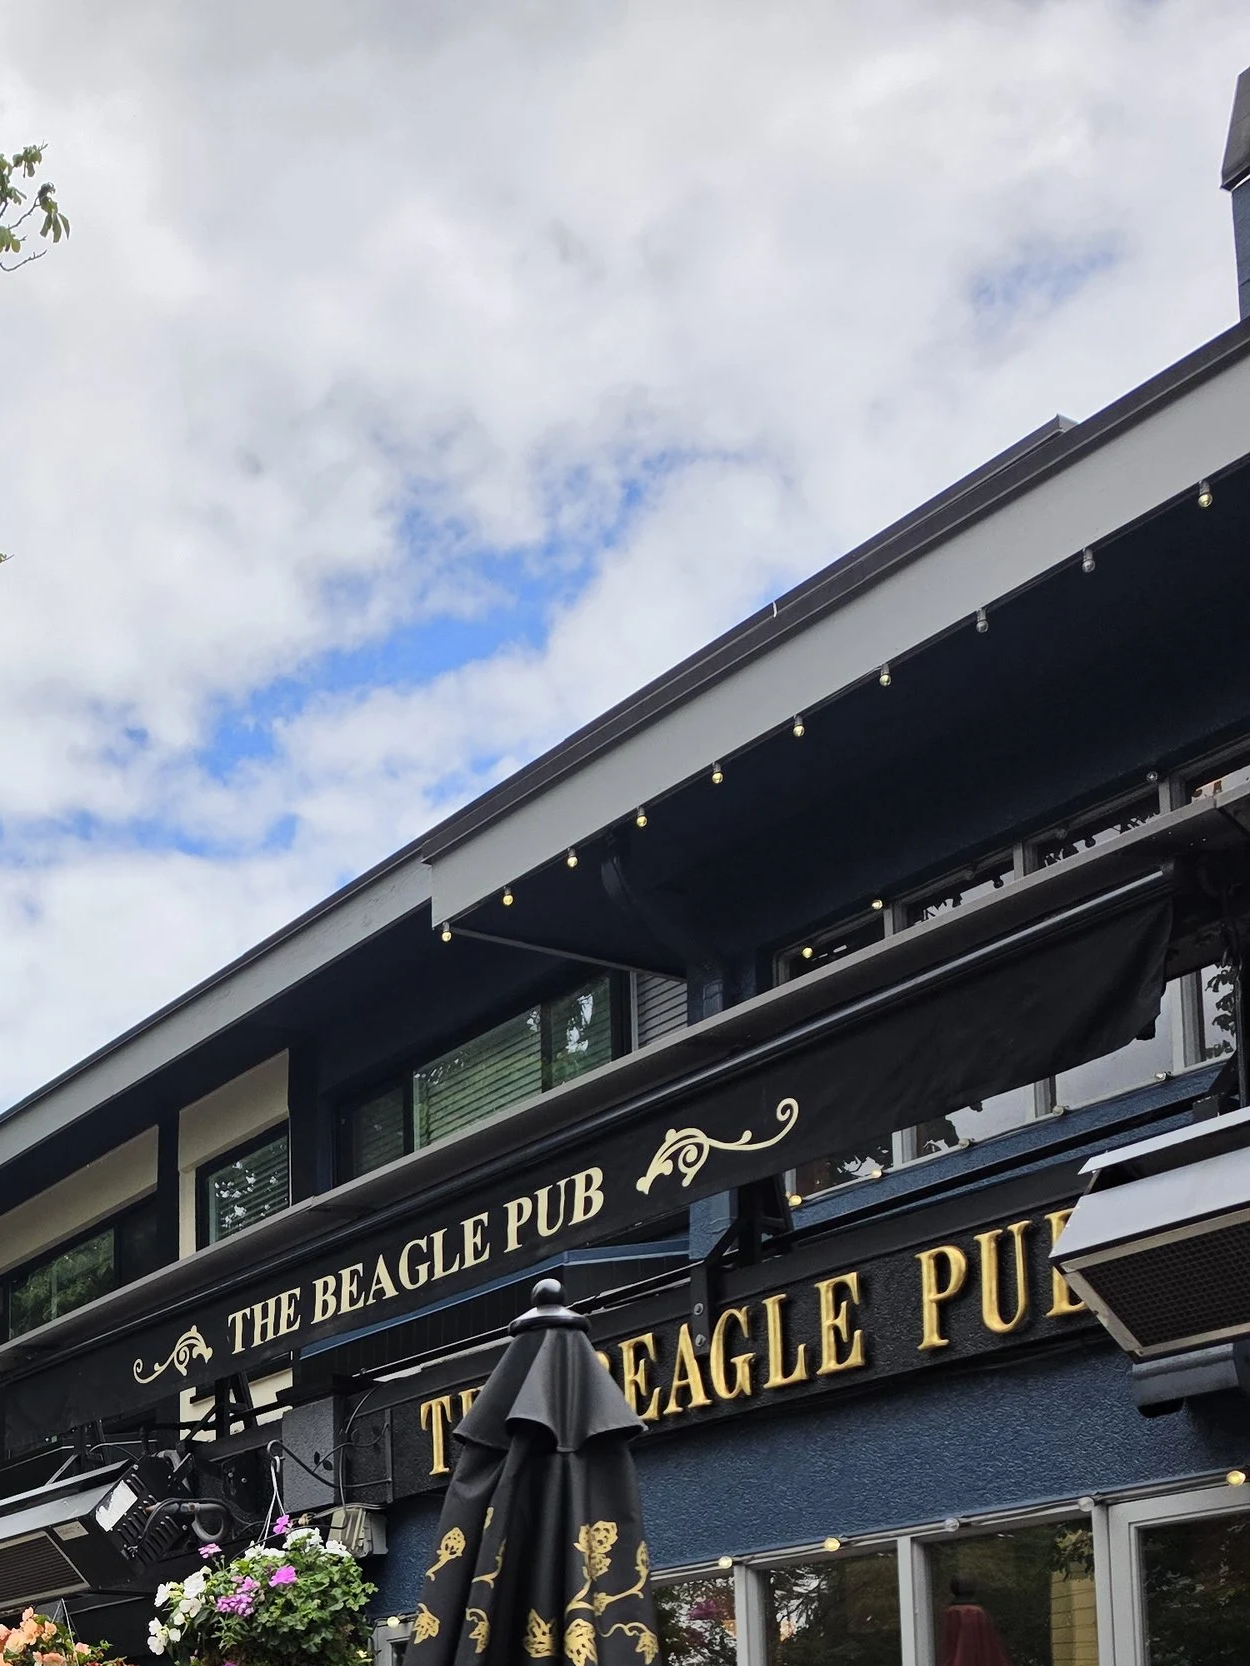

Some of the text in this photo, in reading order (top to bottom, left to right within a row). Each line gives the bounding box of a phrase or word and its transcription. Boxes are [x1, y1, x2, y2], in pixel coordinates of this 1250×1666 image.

[228, 1166, 605, 1355] THE BEAGLE PUB
[595, 1271, 866, 1424] EAGLE
